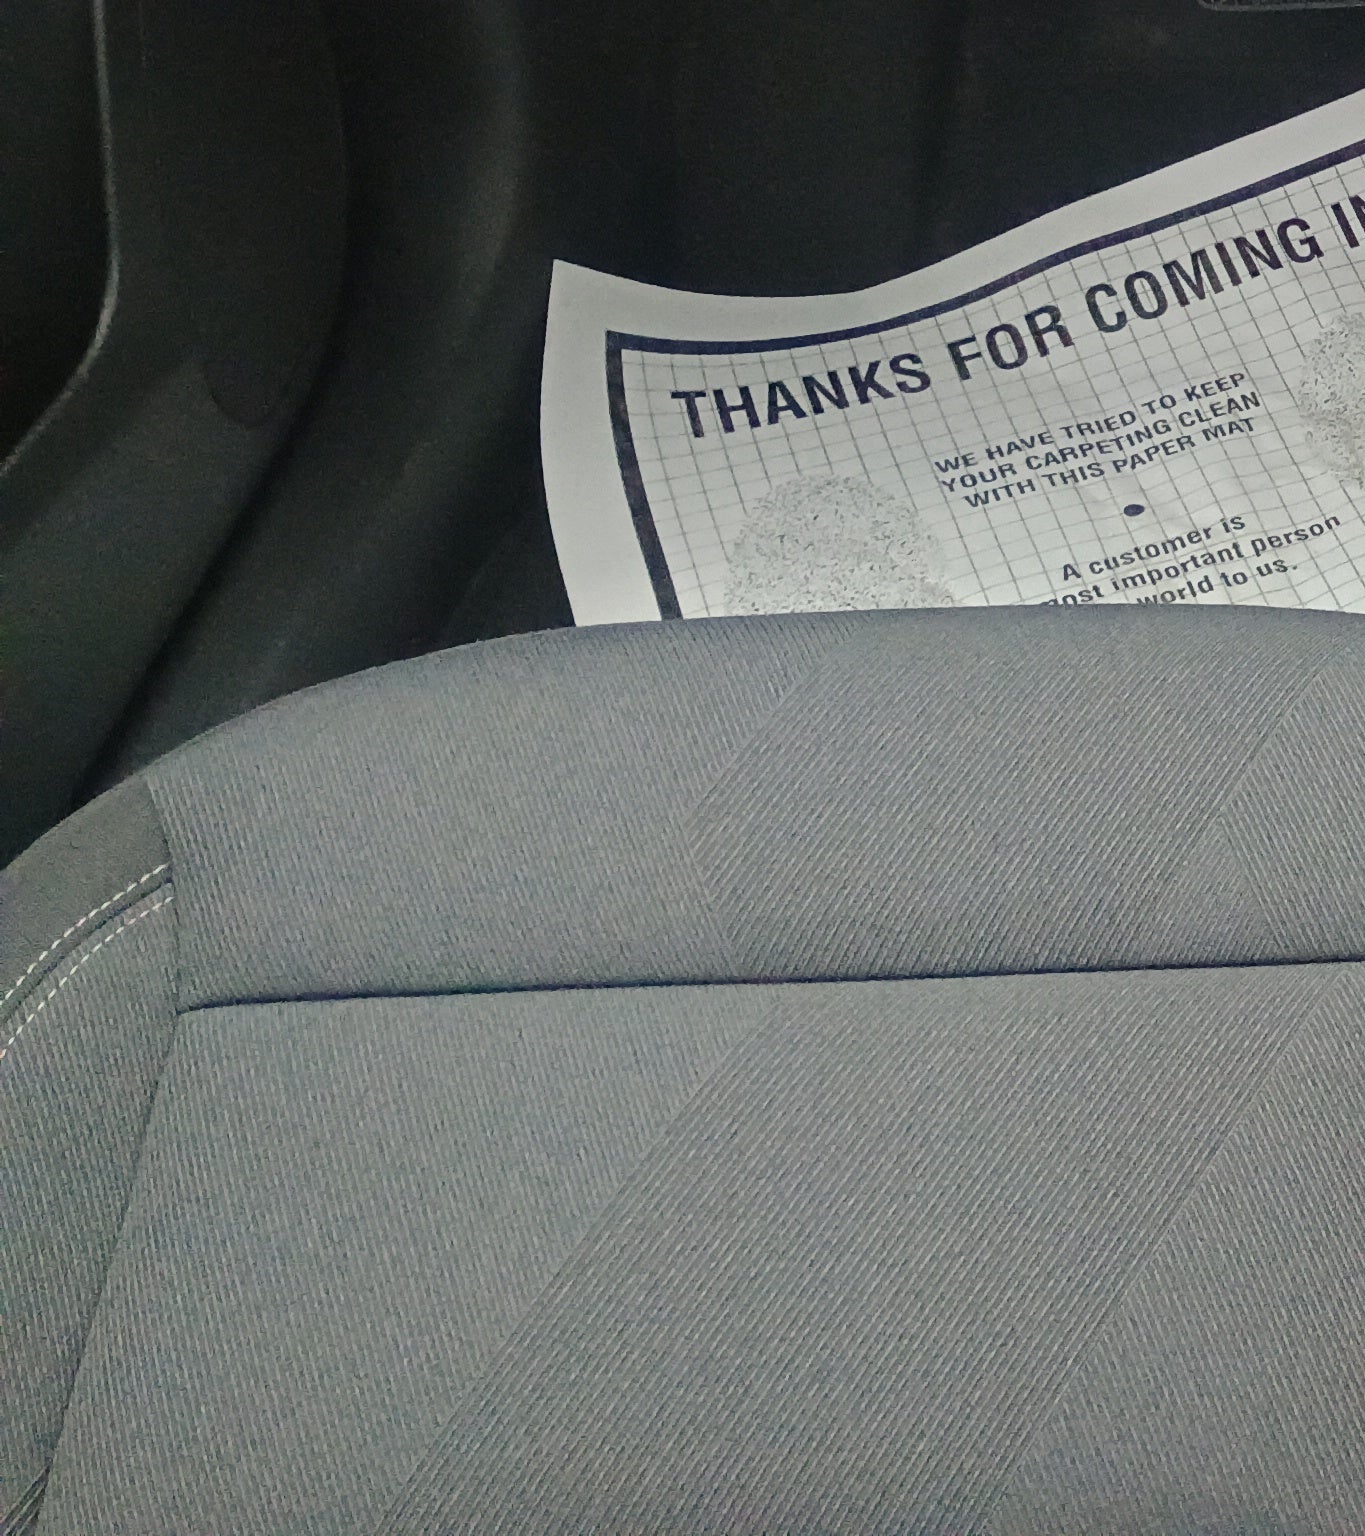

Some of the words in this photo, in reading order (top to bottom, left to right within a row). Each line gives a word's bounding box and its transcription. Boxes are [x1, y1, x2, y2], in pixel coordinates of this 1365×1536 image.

[671, 353, 931, 438] THANKS
[947, 305, 1075, 380] FOR
[1085, 217, 1324, 333] COMING
[934, 452, 978, 474] WE
[985, 431, 1054, 461] HAVE
[1060, 410, 1137, 440] TRIED
[1141, 394, 1176, 415] TO
[1183, 372, 1246, 402] KEEP
[941, 463, 1018, 493] YOUR
[1025, 418, 1172, 470] CARPETING
[1178, 391, 1261, 428] CLEAN
[965, 478, 1036, 508] WITH
[1042, 462, 1105, 488] THIS
[1112, 434, 1196, 473] PAPER
[1202, 417, 1255, 442] MAT
[1063, 562, 1082, 581] A
[1089, 526, 1212, 576] customer
[1220, 515, 1246, 533] is
[1110, 541, 1245, 593] important
[1250, 515, 1341, 557] person
[1136, 576, 1214, 606] world
[1219, 570, 1248, 588] to
[1256, 557, 1299, 577] us.
